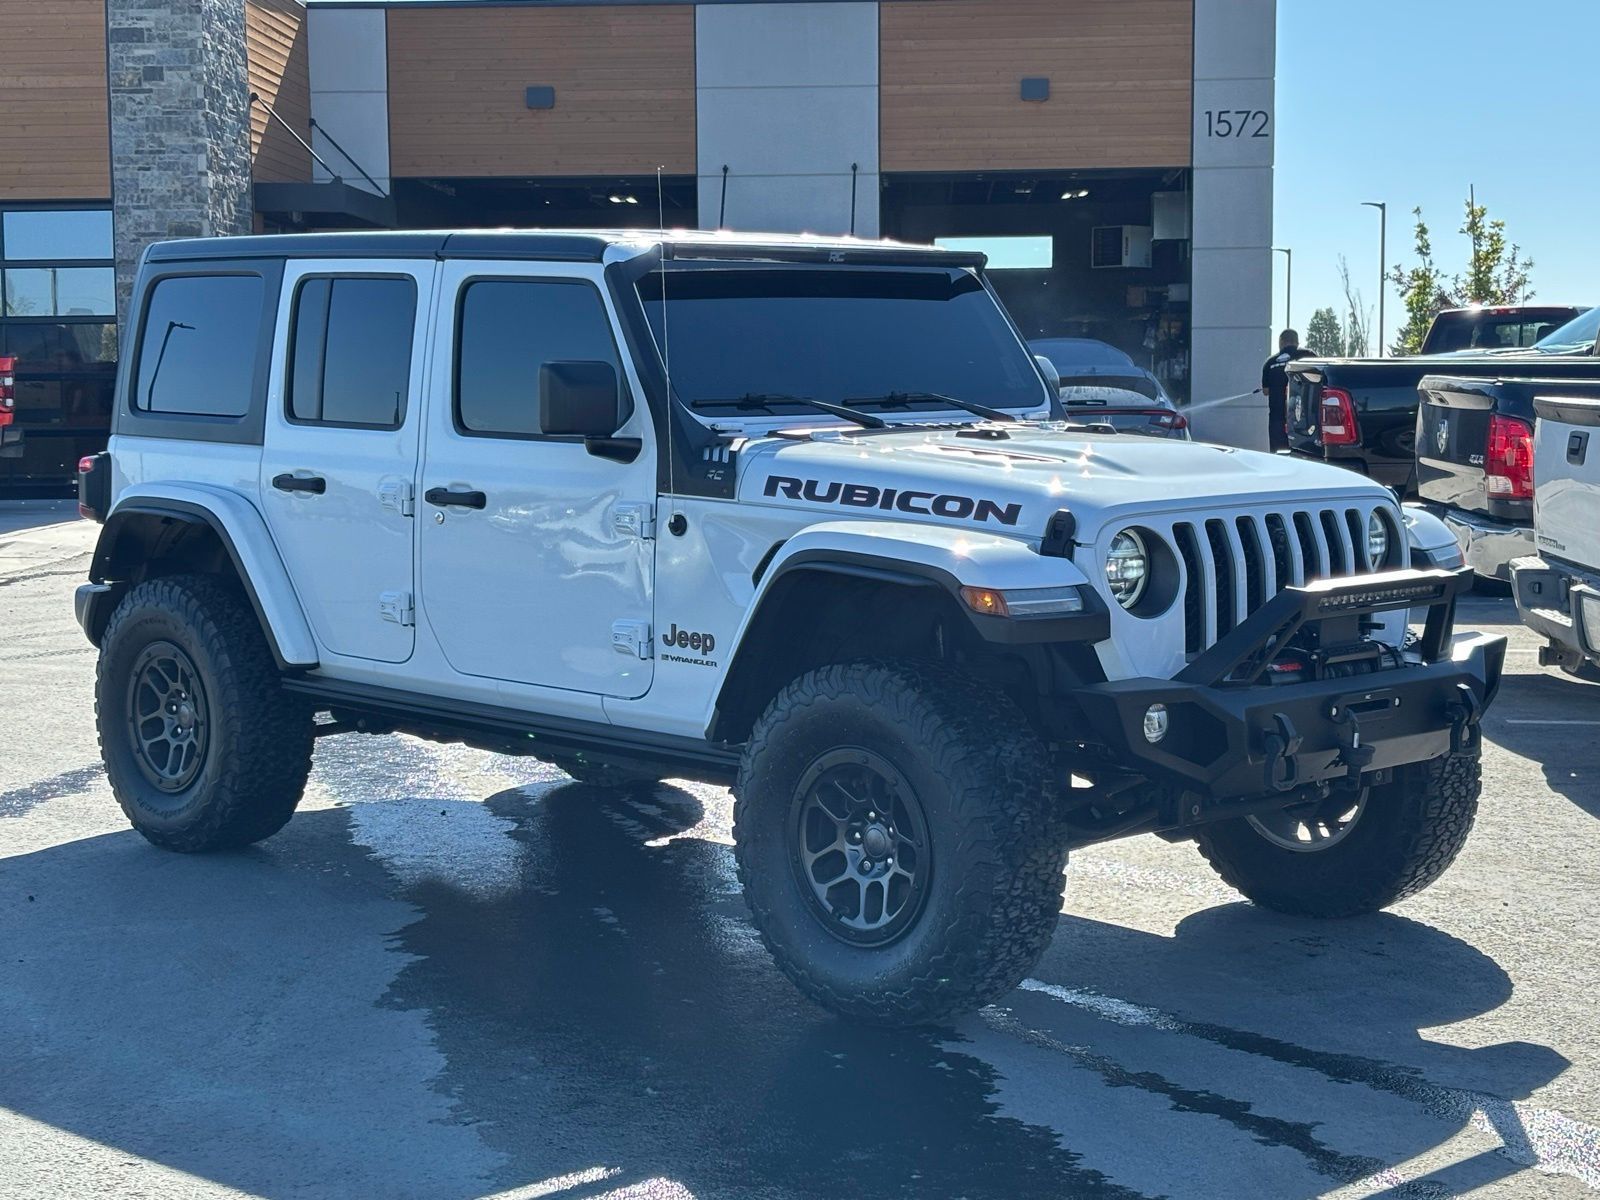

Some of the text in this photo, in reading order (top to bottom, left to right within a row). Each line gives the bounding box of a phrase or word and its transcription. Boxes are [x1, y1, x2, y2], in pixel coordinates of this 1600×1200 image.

[1204, 110, 1269, 137] 1572
[763, 474, 1023, 526] RUBICON
[662, 623, 715, 656] Jeep
[669, 654, 718, 667] WRANGLER
